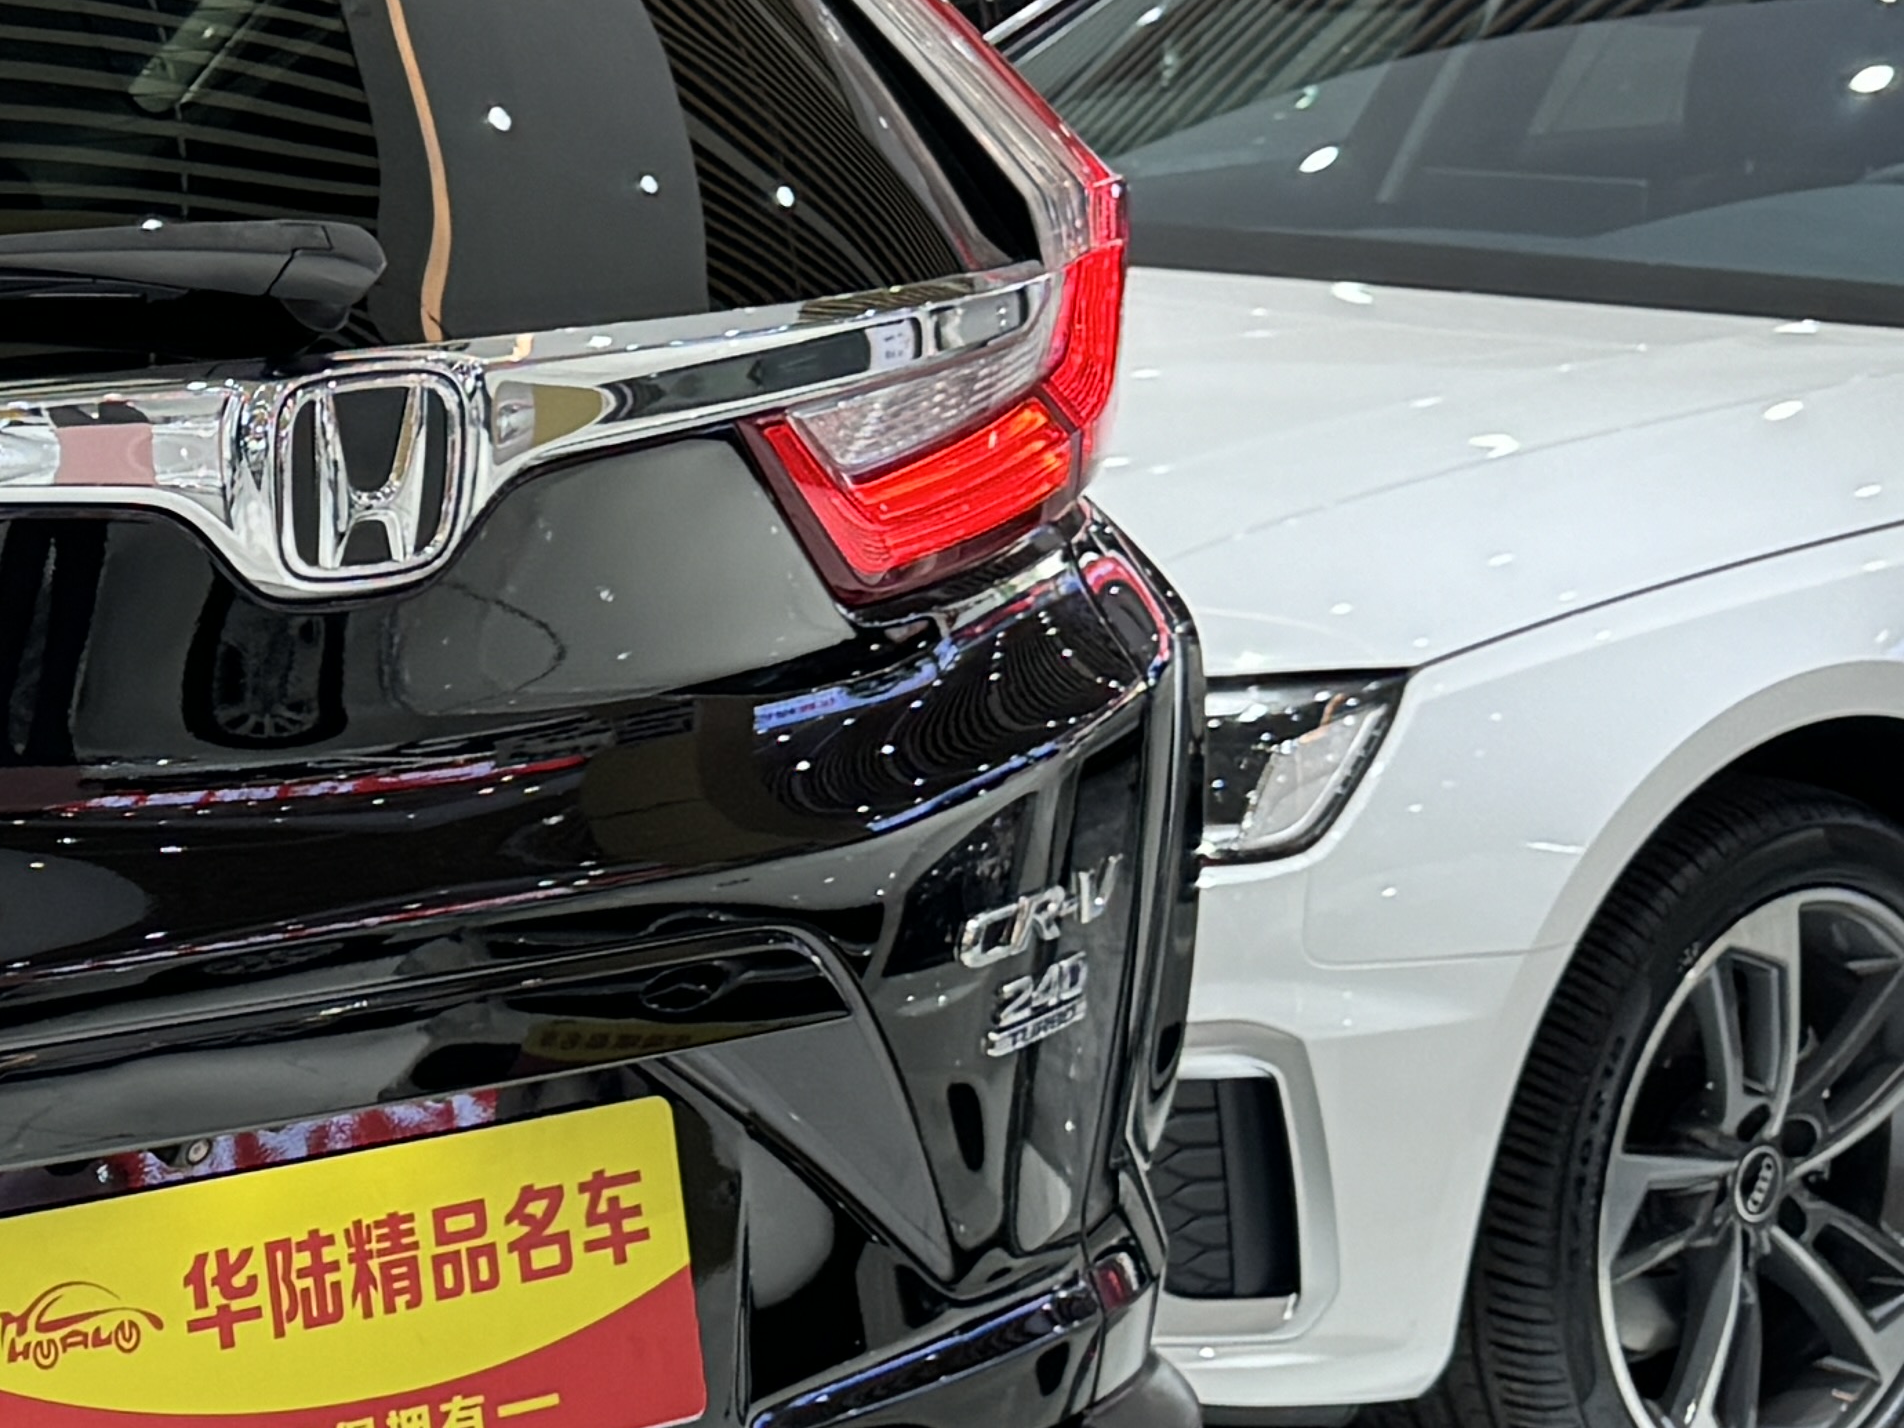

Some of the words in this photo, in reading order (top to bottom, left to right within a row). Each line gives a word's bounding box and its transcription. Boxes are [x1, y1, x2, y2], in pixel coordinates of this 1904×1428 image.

[996, 952, 1087, 1027] 240
[183, 1168, 652, 1350] 华陆精品名车
